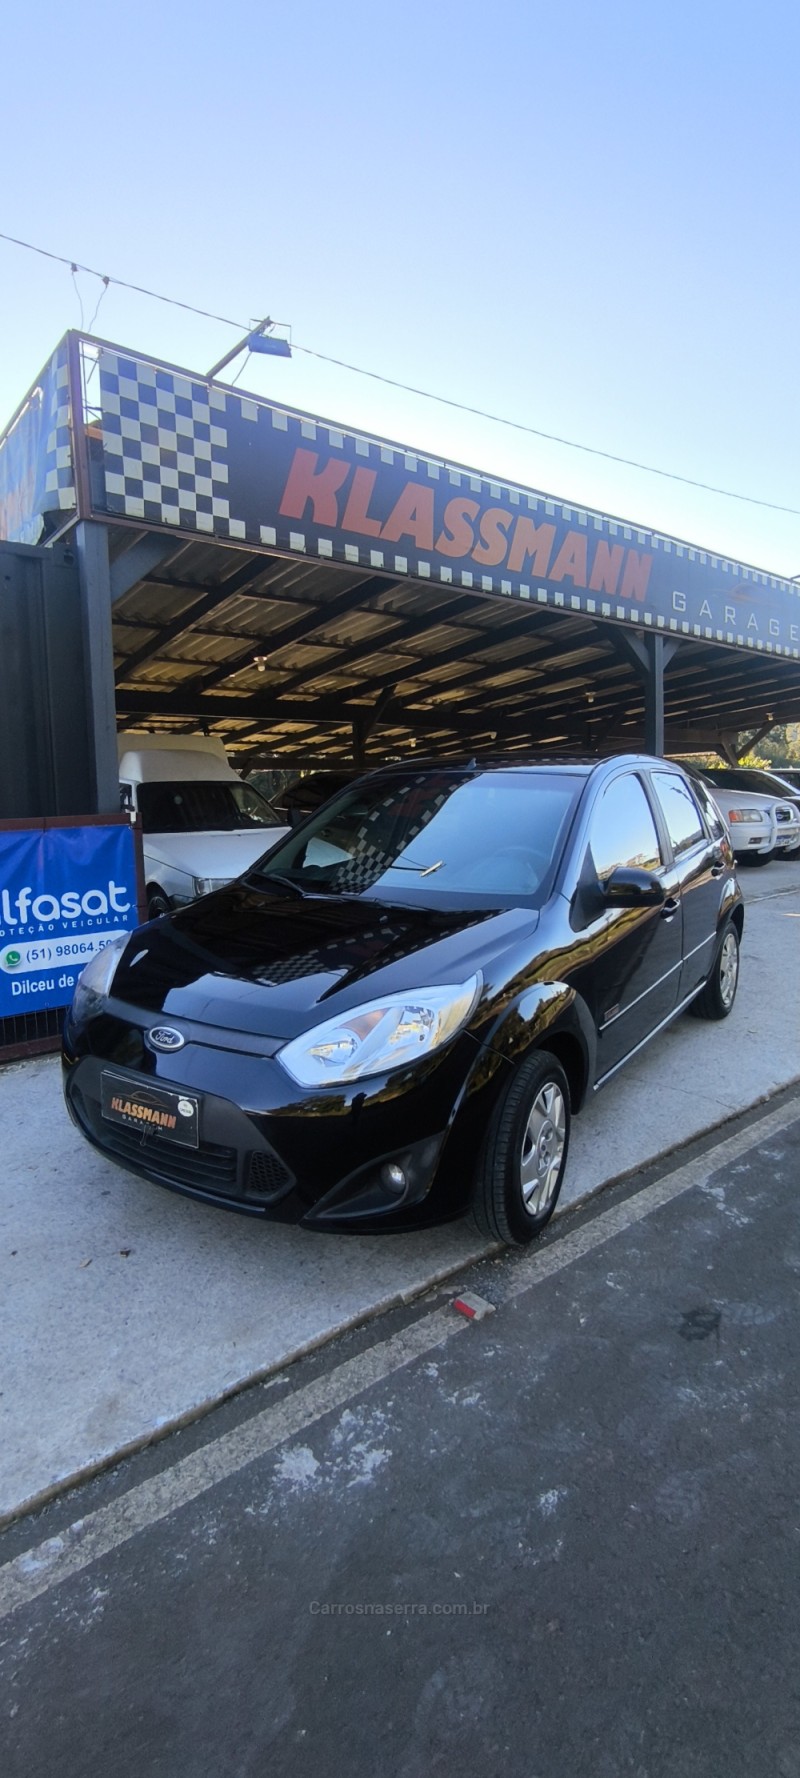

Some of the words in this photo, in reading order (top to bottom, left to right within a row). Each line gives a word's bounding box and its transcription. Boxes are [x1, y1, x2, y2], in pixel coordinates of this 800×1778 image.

[278, 447, 653, 602] KLASSMANN
[0, 880, 130, 925] lfasat
[62, 915, 128, 929] VEICULAR
[26, 948, 52, 963] (51)
[11, 978, 55, 996] Dilceu
[58, 973, 75, 988] de
[155, 1031, 174, 1044] Ford
[111, 1097, 177, 1129] KLASSMANN
